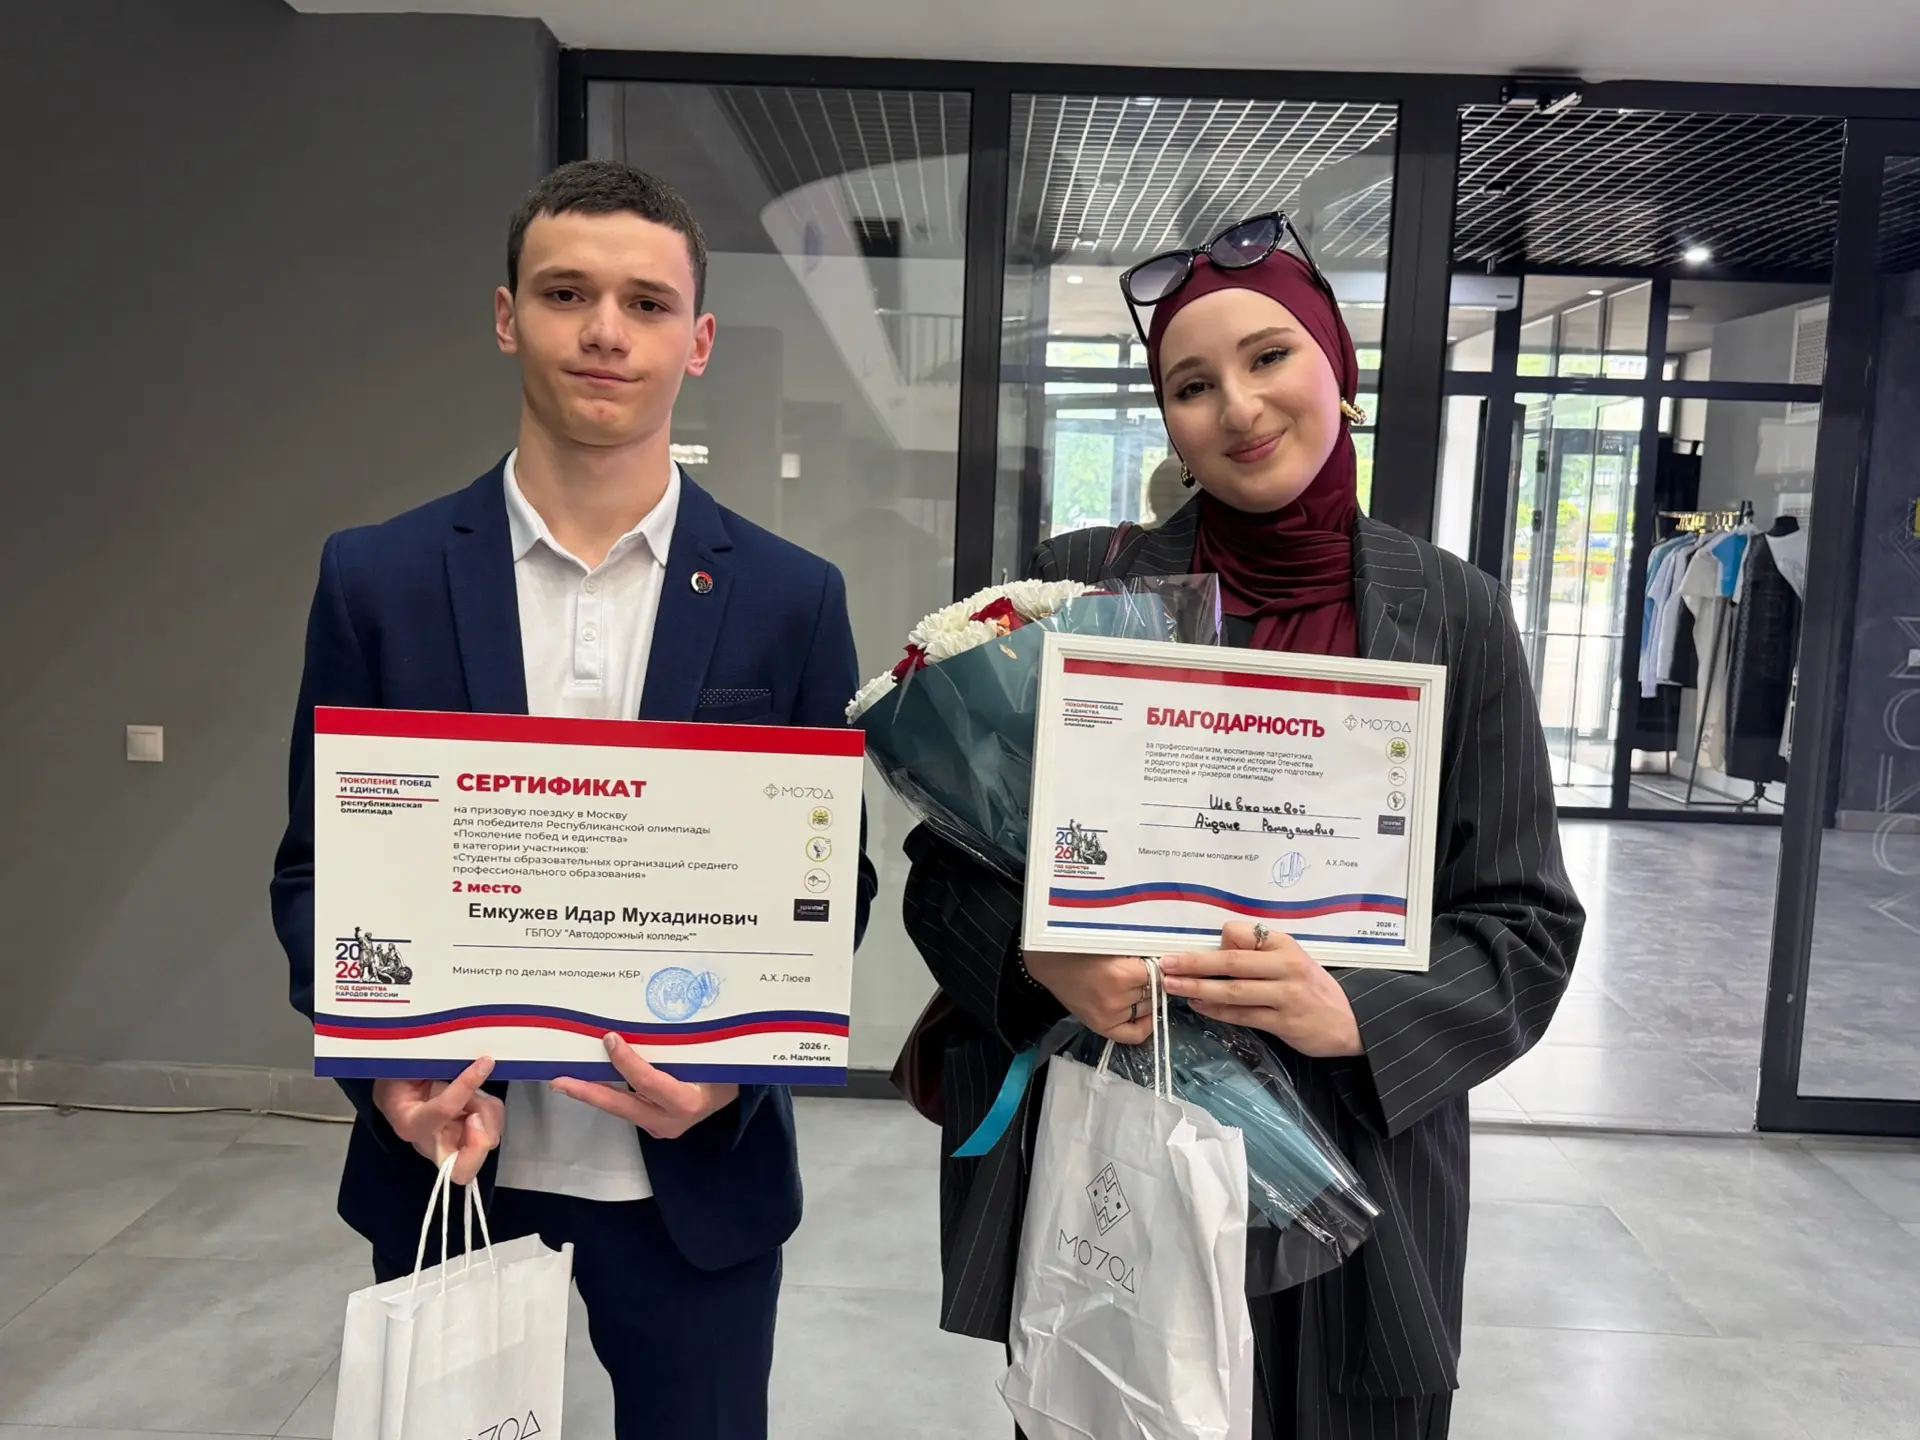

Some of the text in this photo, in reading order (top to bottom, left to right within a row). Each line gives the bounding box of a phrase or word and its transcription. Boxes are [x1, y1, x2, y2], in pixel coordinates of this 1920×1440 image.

[1146, 706, 1325, 738] БЛАГОДАРНОСТЬ
[1145, 750, 1179, 758] привитие
[1211, 755, 1245, 764] изучению
[1277, 759, 1314, 768] Отечества
[1223, 748, 1265, 757] воспитание
[1144, 766, 1190, 776] победителей
[1197, 770, 1231, 779] призеров
[1232, 772, 1274, 782] олимпиады
[1150, 759, 1180, 767] родного
[1243, 764, 1283, 775] блестящую
[1284, 769, 1324, 778] подготовку
[339, 776, 432, 788] ПОКОЛЕНИЕ ПОБЕД
[456, 772, 647, 798] СЕРТИФИКАТ
[1143, 775, 1188, 784] выражается
[349, 785, 400, 795] ЕДИНСТВА
[340, 800, 422, 809] республиканская
[453, 806, 467, 814] на
[470, 806, 526, 816] призовую
[529, 809, 574, 820] поездку
[586, 809, 628, 821] Москву
[452, 818, 711, 835] для победителя Республиканской олимпиады
[452, 828, 522, 840] «Поколение
[524, 831, 560, 842] побед
[570, 834, 628, 844] единства»
[452, 841, 589, 854] в категории участников:
[1054, 845, 1073, 860] 26
[1138, 846, 1171, 857] Министр
[1181, 850, 1205, 858] делам
[1206, 852, 1243, 861] молодежи
[1244, 853, 1259, 862] КБР
[452, 853, 739, 871] «Студенты образовательных организаций среднего
[452, 865, 646, 879] профессионального образования»
[451, 880, 522, 894] 2 место
[468, 902, 758, 927] Емкужев Идар Мухадинович
[524, 927, 562, 938] ГБПОУ
[564, 928, 644, 940] "Автодорожный
[336, 943, 361, 961] 20
[335, 961, 361, 979] 26
[452, 965, 641, 979] Министр по делам молодежи КБР
[780, 973, 811, 983] Люев
[798, 1041, 822, 1050] 2026
[789, 1053, 831, 1062] Нальчик
